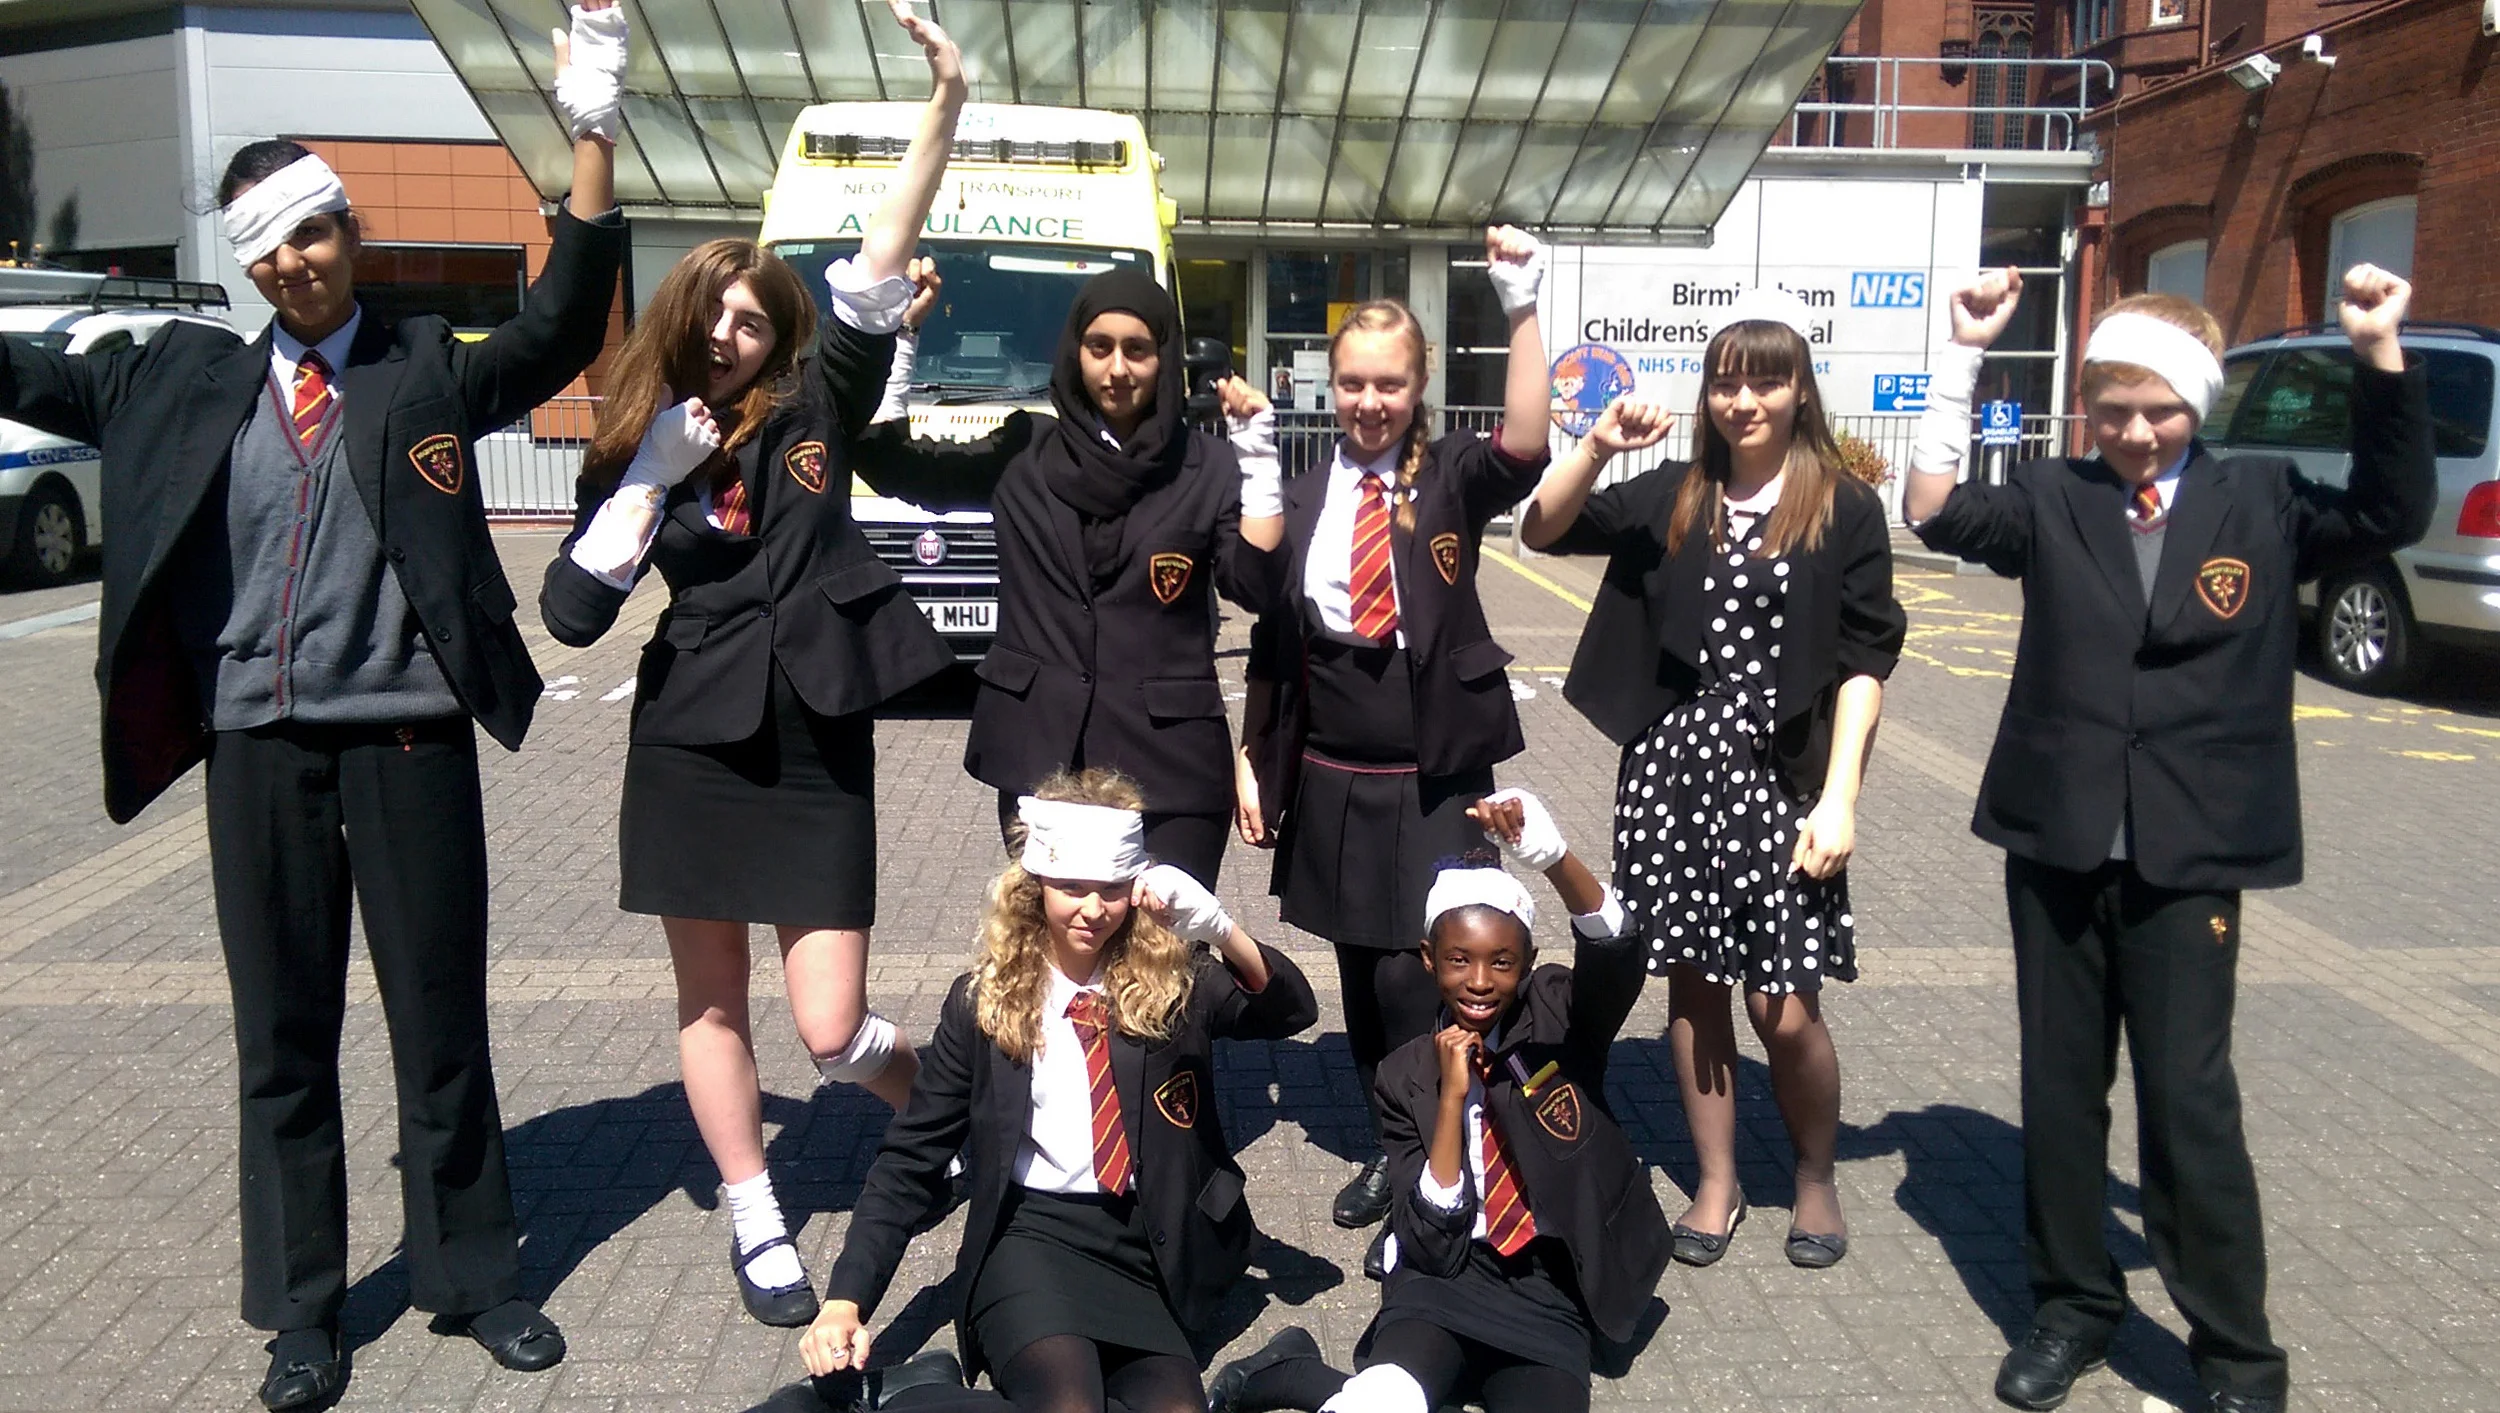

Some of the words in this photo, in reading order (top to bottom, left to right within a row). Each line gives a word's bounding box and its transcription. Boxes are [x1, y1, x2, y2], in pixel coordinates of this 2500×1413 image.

[958, 181, 1082, 200] TRANSPORT
[837, 212, 1084, 240] AULANCE
[1673, 281, 1835, 307] Birmiam
[1851, 274, 1923, 306] NHS
[1584, 318, 1709, 344] Children's
[1638, 358, 1675, 373] NHS
[921, 542, 939, 557] FIAT
[943, 605, 989, 626] MHU
